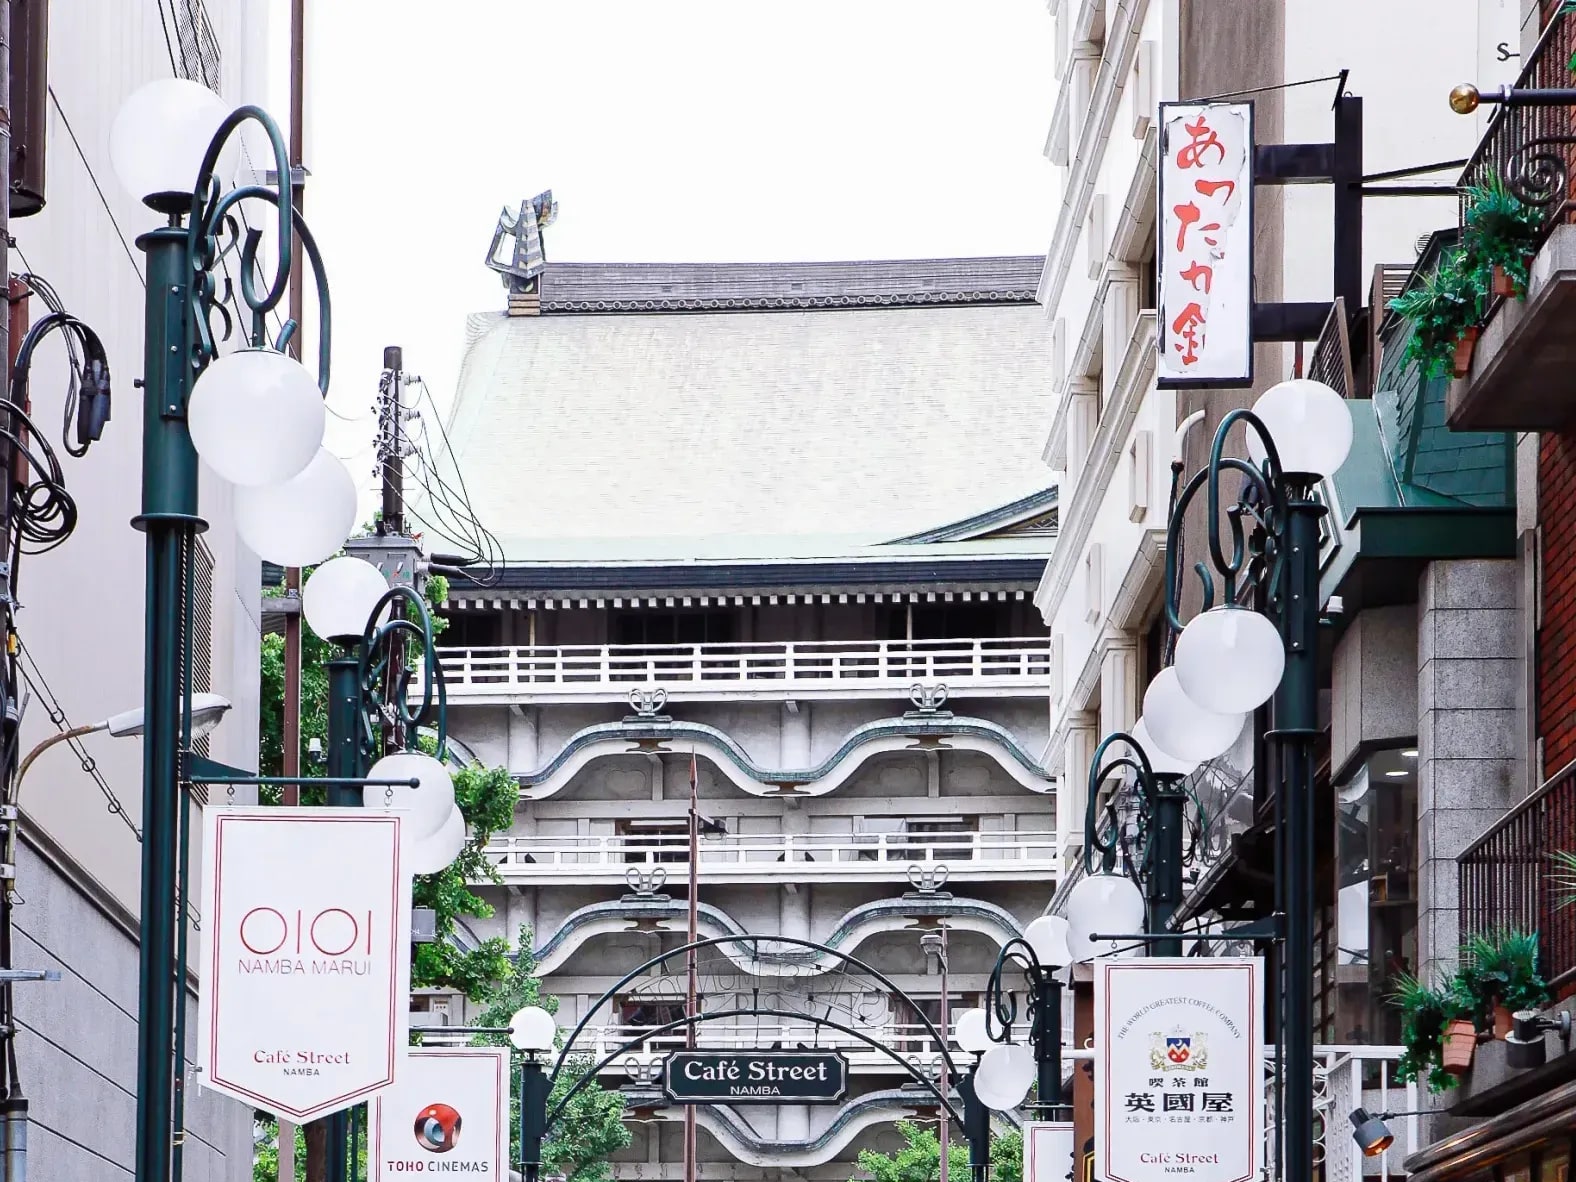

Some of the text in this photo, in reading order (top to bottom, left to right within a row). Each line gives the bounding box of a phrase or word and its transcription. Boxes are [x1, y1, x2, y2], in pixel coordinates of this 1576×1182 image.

[239, 959, 371, 976] NAMBA MARUI
[1117, 997, 1241, 1039] THE WORLD GREATEST COFFEE COMPANY
[254, 1050, 351, 1066] Café Street
[283, 1068, 320, 1076] NAMBA
[684, 1060, 828, 1081] Café Street
[1149, 1077, 1209, 1088] 喫茶館
[730, 1086, 781, 1095] NAMBA
[1124, 1092, 1234, 1113] 英國屋
[1140, 1152, 1219, 1164] Café Street
[387, 1161, 489, 1172] TOHO CINEMAS
